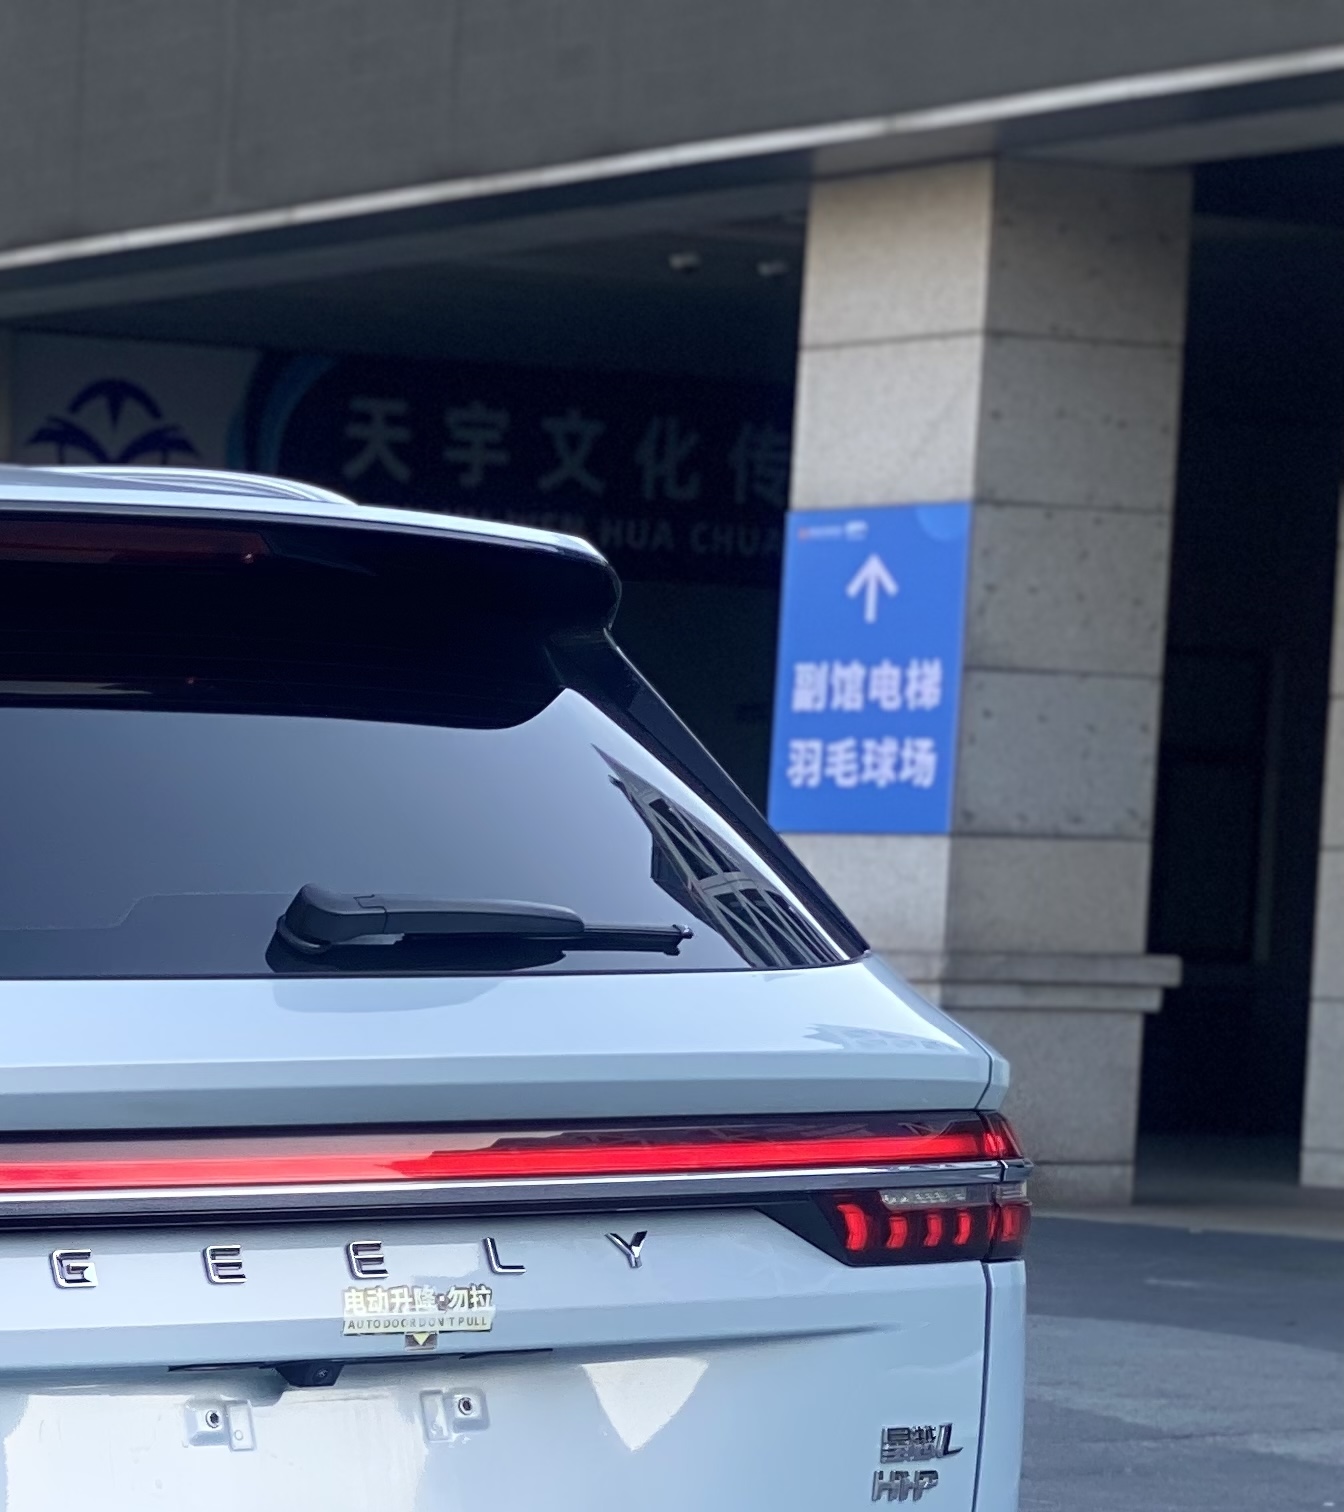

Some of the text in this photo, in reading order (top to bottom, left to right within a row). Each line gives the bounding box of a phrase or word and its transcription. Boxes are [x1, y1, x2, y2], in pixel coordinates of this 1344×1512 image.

[341, 396, 788, 508] 天宇文化传
[786, 736, 938, 789] 羽毛球场
[49, 1230, 647, 1289] GEELY
[348, 1319, 381, 1330] AUTO
[458, 1316, 488, 1328] PULL
